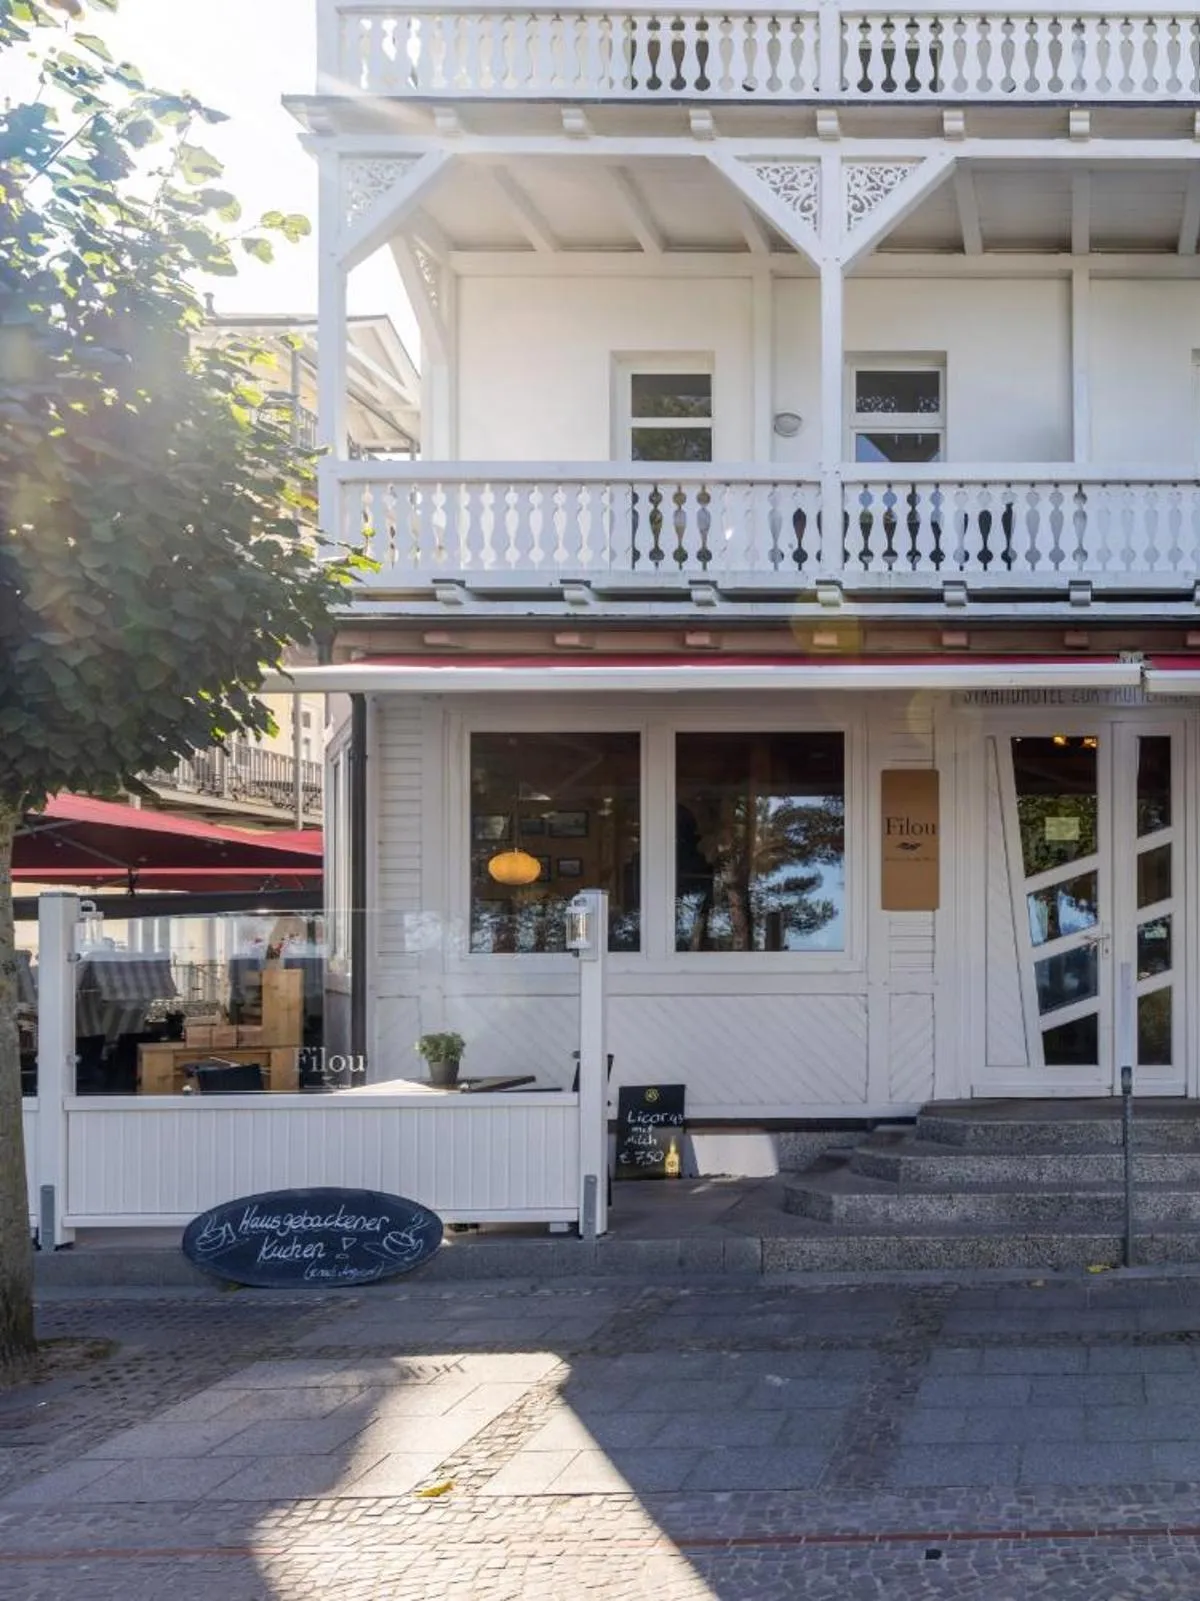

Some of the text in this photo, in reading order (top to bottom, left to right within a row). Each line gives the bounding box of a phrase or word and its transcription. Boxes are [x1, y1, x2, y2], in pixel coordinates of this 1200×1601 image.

[884, 815, 936, 836] Filou
[291, 1045, 366, 1073] Filou
[238, 1203, 390, 1237] Hausgebackener
[256, 1235, 327, 1263] Kuchen
